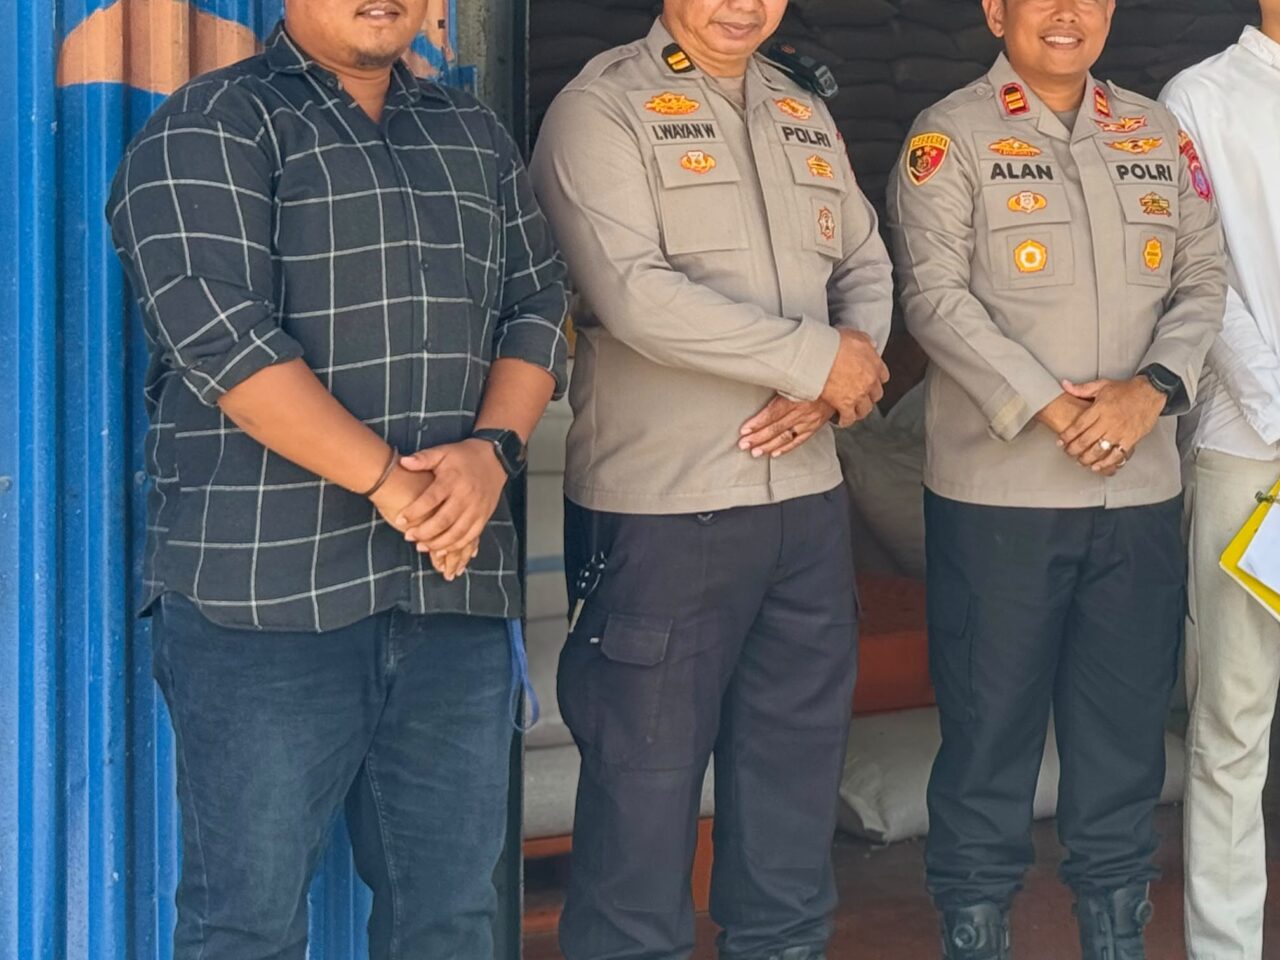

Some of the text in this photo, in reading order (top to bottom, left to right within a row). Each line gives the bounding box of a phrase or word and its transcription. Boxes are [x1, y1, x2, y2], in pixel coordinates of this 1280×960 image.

[782, 126, 832, 148] POLRI
[991, 162, 1054, 181] ALAN
[1116, 164, 1173, 182] POLRI
